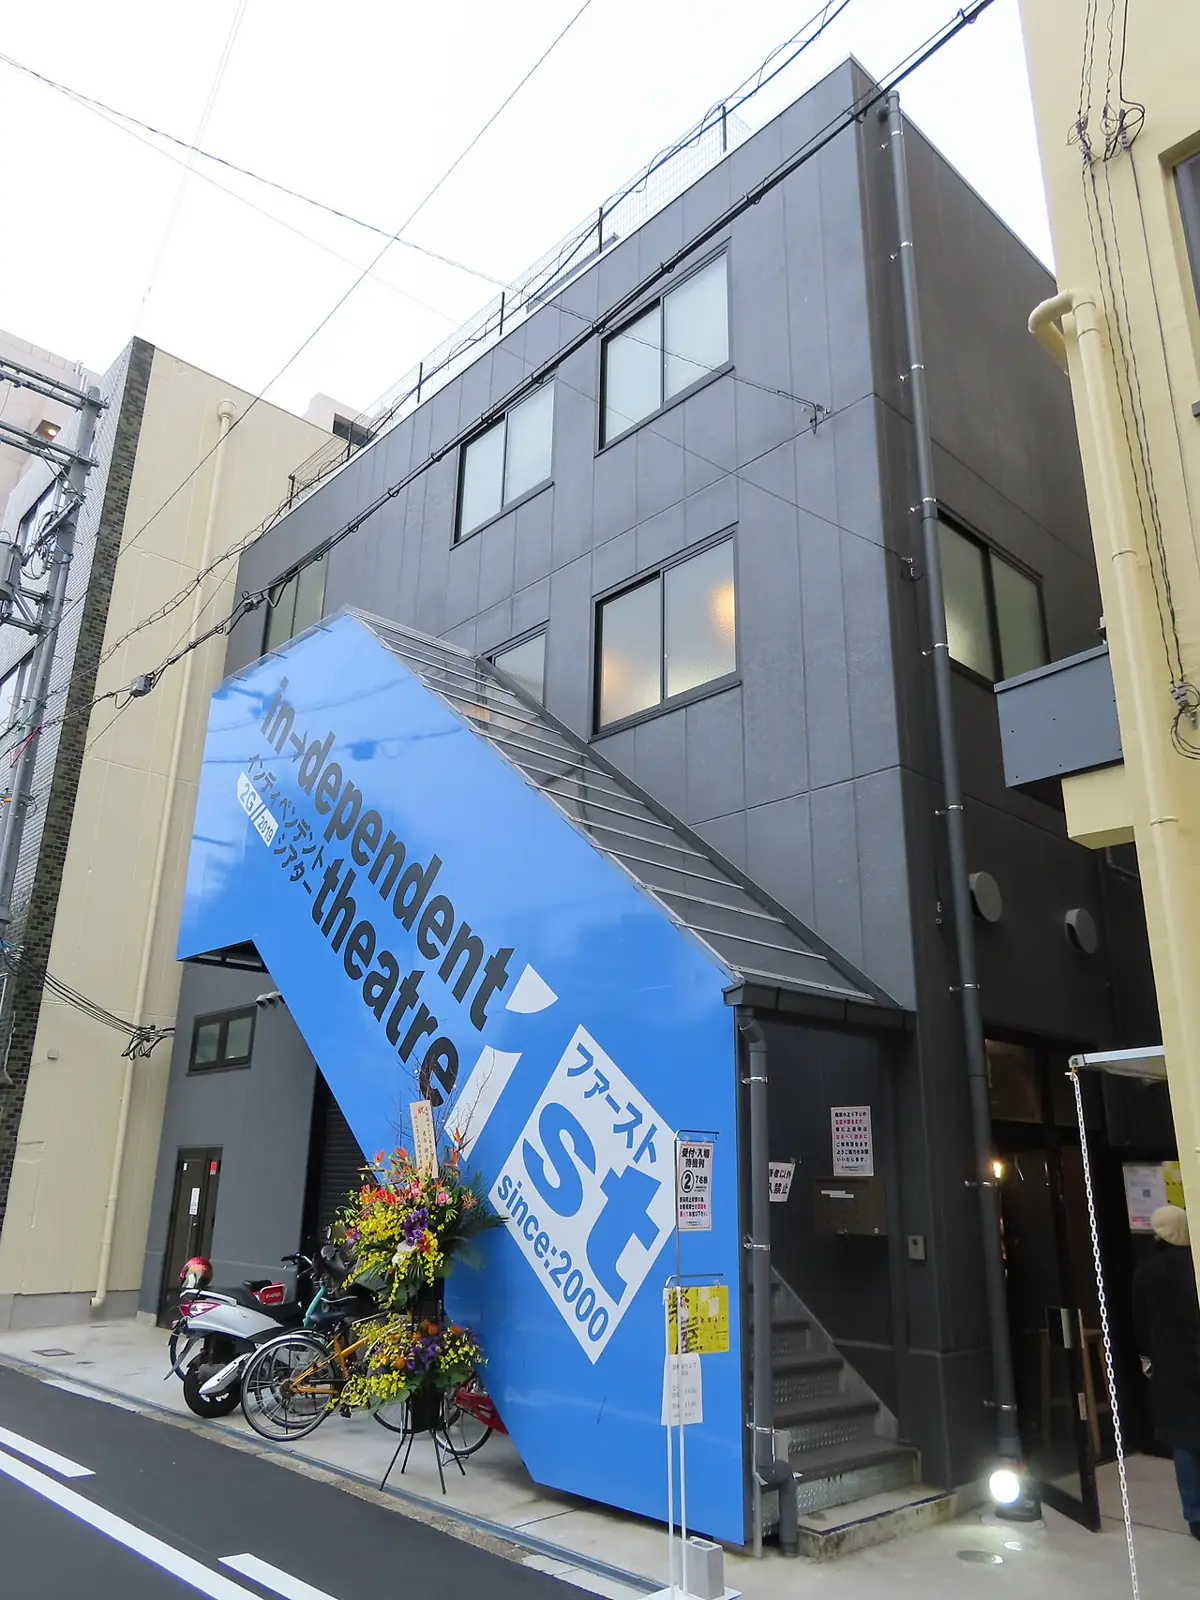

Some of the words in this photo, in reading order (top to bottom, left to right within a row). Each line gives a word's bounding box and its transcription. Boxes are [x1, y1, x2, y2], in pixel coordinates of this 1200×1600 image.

[239, 783, 257, 813] 2G
[257, 815, 274, 843] 2019
[248, 754, 324, 870] インディペンデント
[274, 832, 312, 895] シアター
[311, 858, 459, 1106] theatre
[566, 1043, 659, 1164] ファースト
[681, 1148, 710, 1158] 受付・入場
[498, 1175, 609, 1342] since:2000
